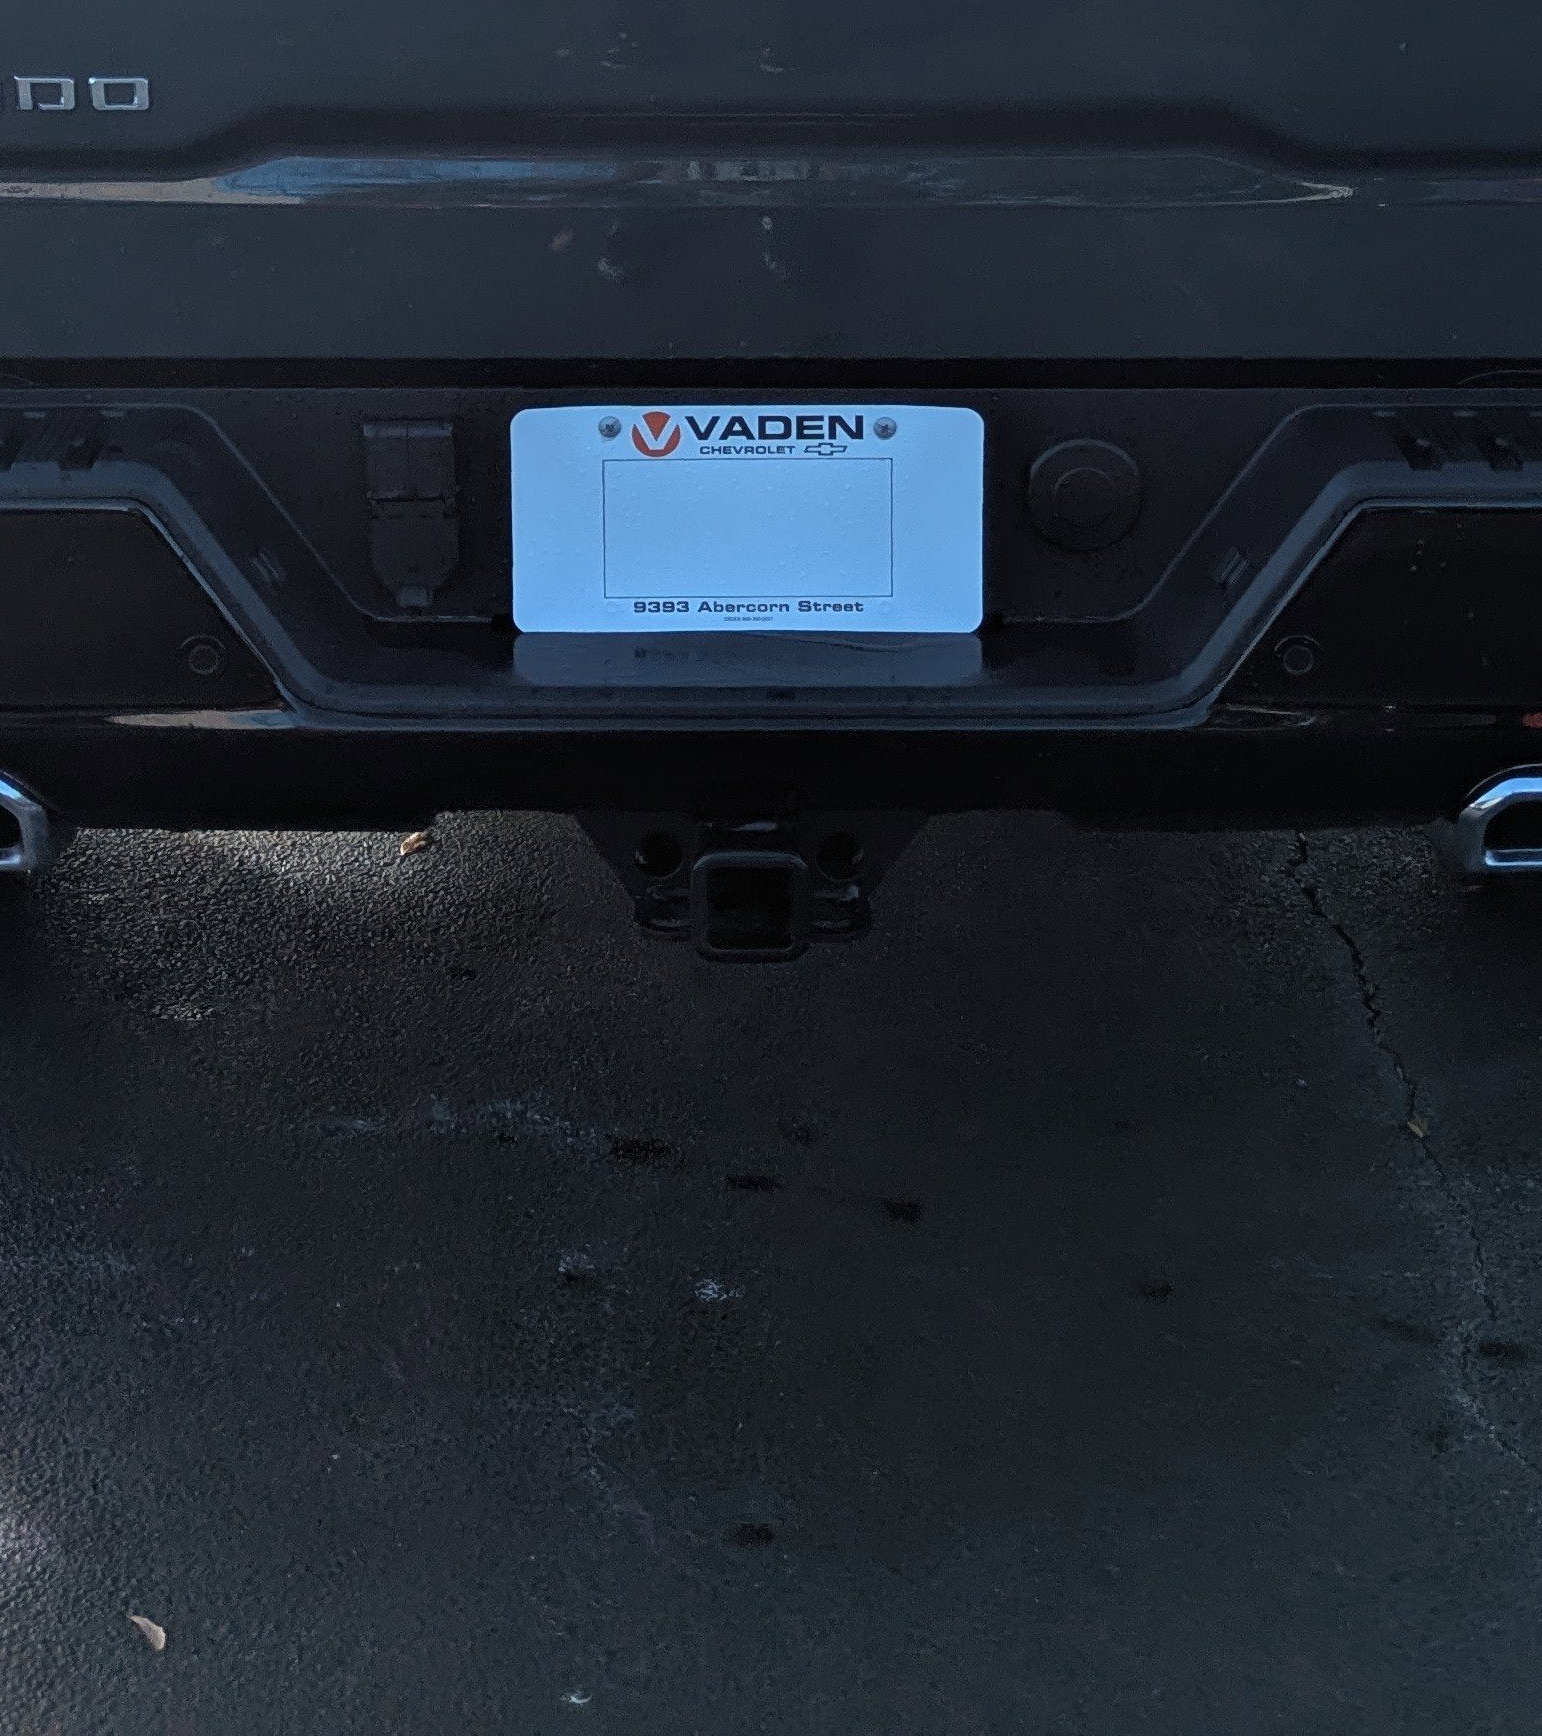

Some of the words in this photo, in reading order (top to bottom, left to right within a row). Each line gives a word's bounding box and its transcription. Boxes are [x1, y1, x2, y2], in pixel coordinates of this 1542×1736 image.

[684, 414, 865, 440] VADEN
[699, 444, 796, 456] CHEVROLET
[632, 600, 690, 614] 9393
[697, 599, 790, 614] Abercorn
[797, 599, 865, 614] Street
